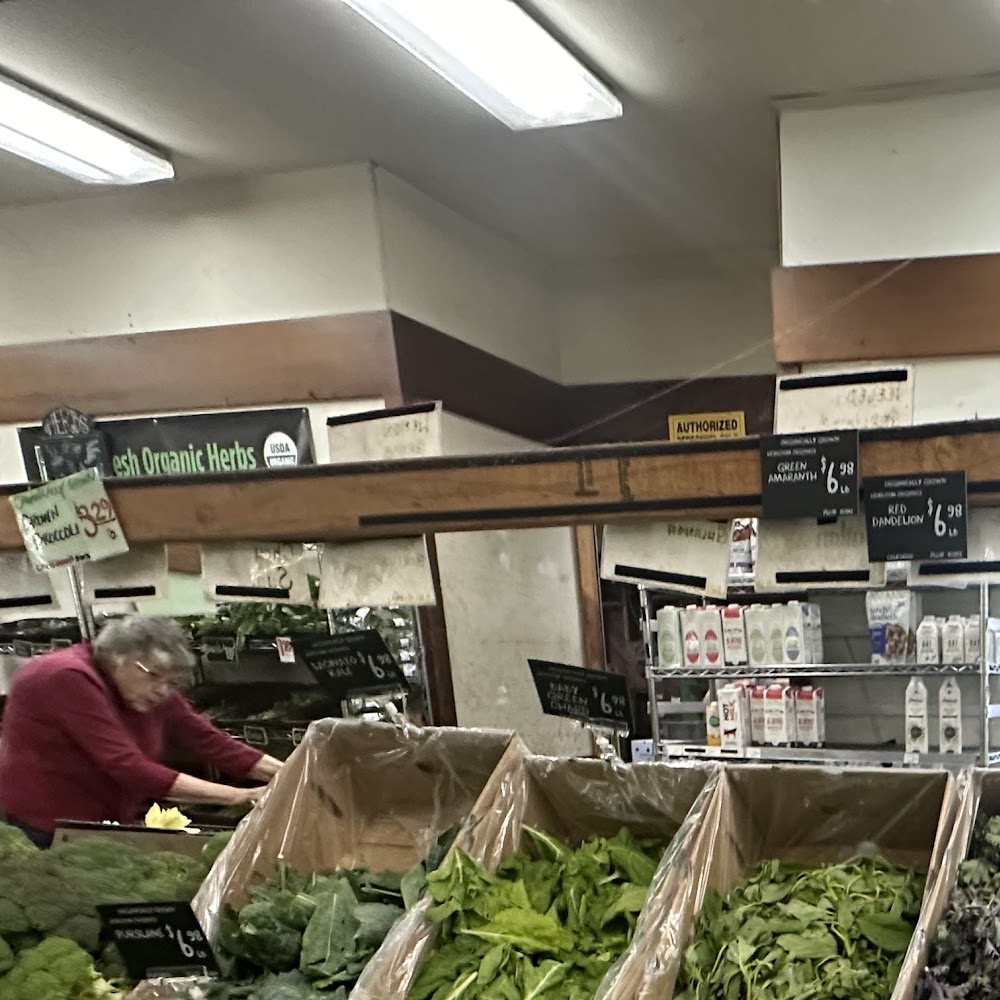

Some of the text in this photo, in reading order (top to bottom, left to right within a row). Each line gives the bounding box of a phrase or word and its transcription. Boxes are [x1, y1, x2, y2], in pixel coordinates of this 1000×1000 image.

[677, 420, 738, 433] AUTHORIZED
[270, 443, 291, 453] USDA
[142, 443, 205, 475] Organic
[206, 440, 257, 473] Herbs
[777, 461, 807, 473] GREEN
[768, 471, 817, 484] AMARANTH
[888, 504, 907, 515] RED
[872, 514, 924, 528] DANDELION
